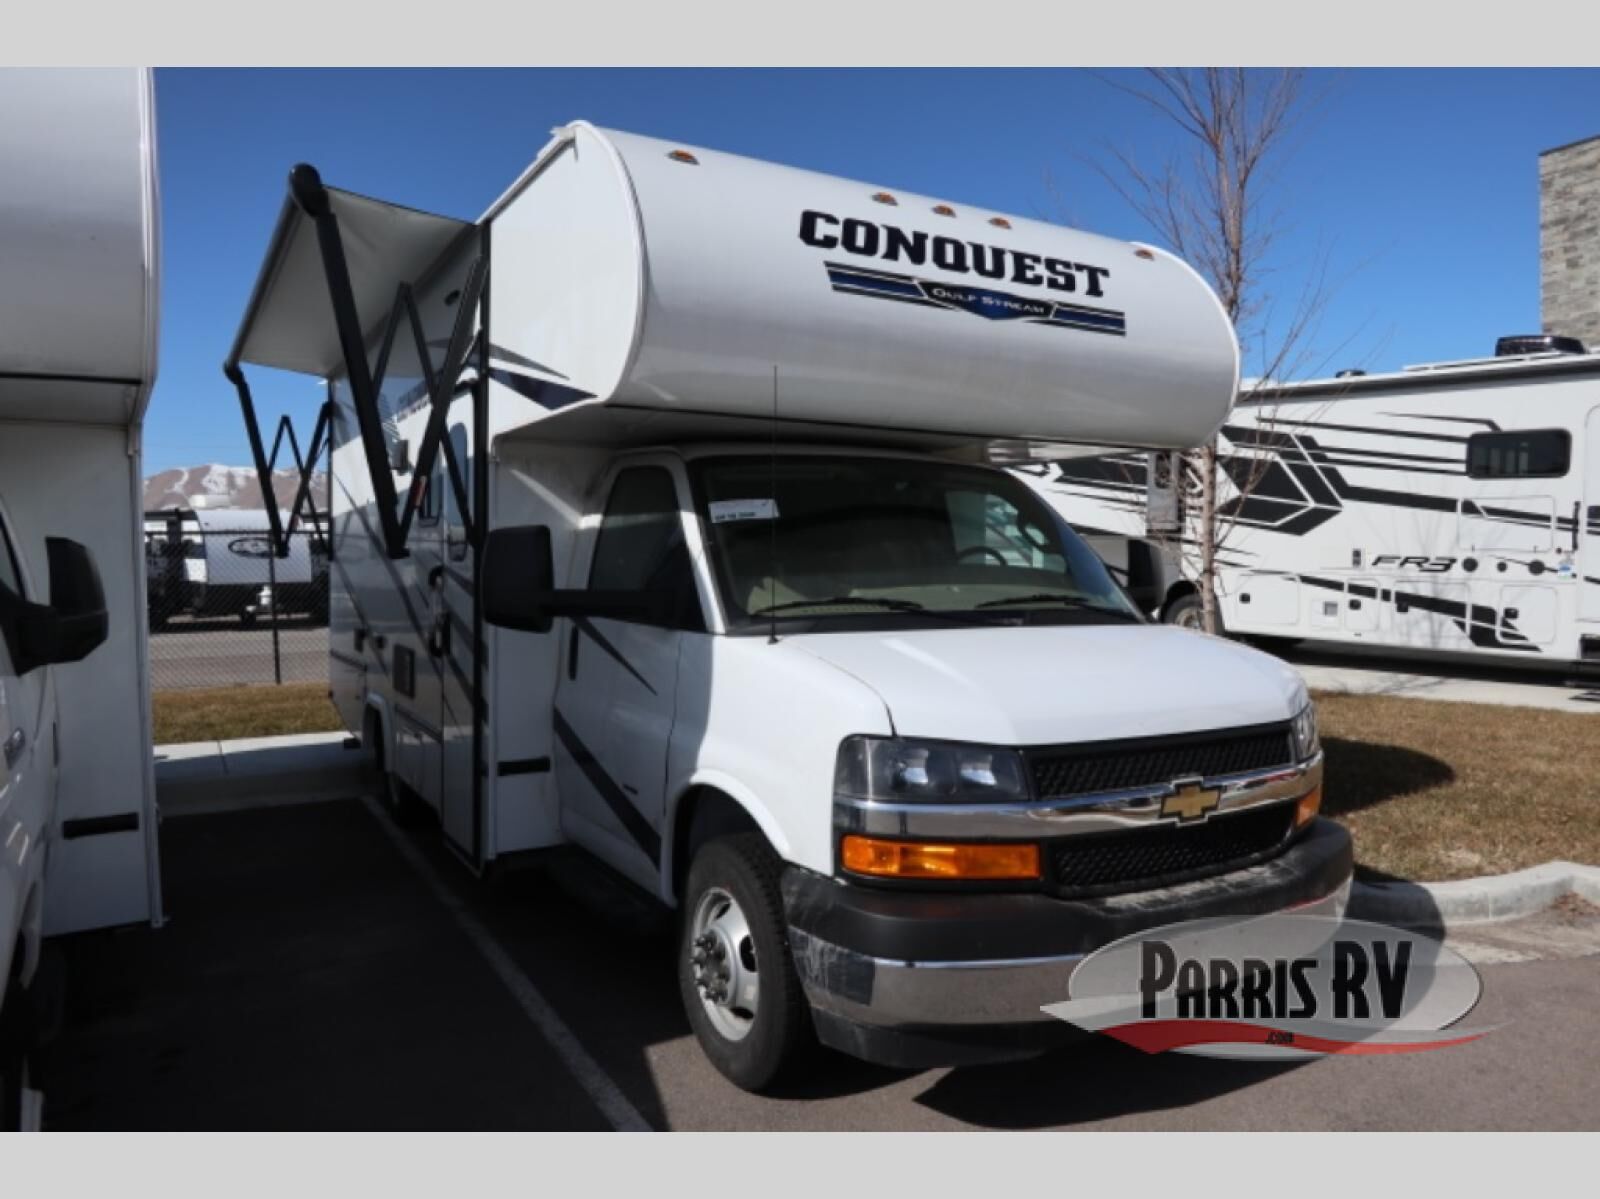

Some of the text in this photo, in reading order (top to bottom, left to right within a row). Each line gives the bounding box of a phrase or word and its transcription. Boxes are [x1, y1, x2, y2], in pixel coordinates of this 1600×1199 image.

[799, 209, 1110, 297] CONQUEST
[931, 288, 1045, 314] GULF STREAM
[1372, 556, 1457, 573] FR3
